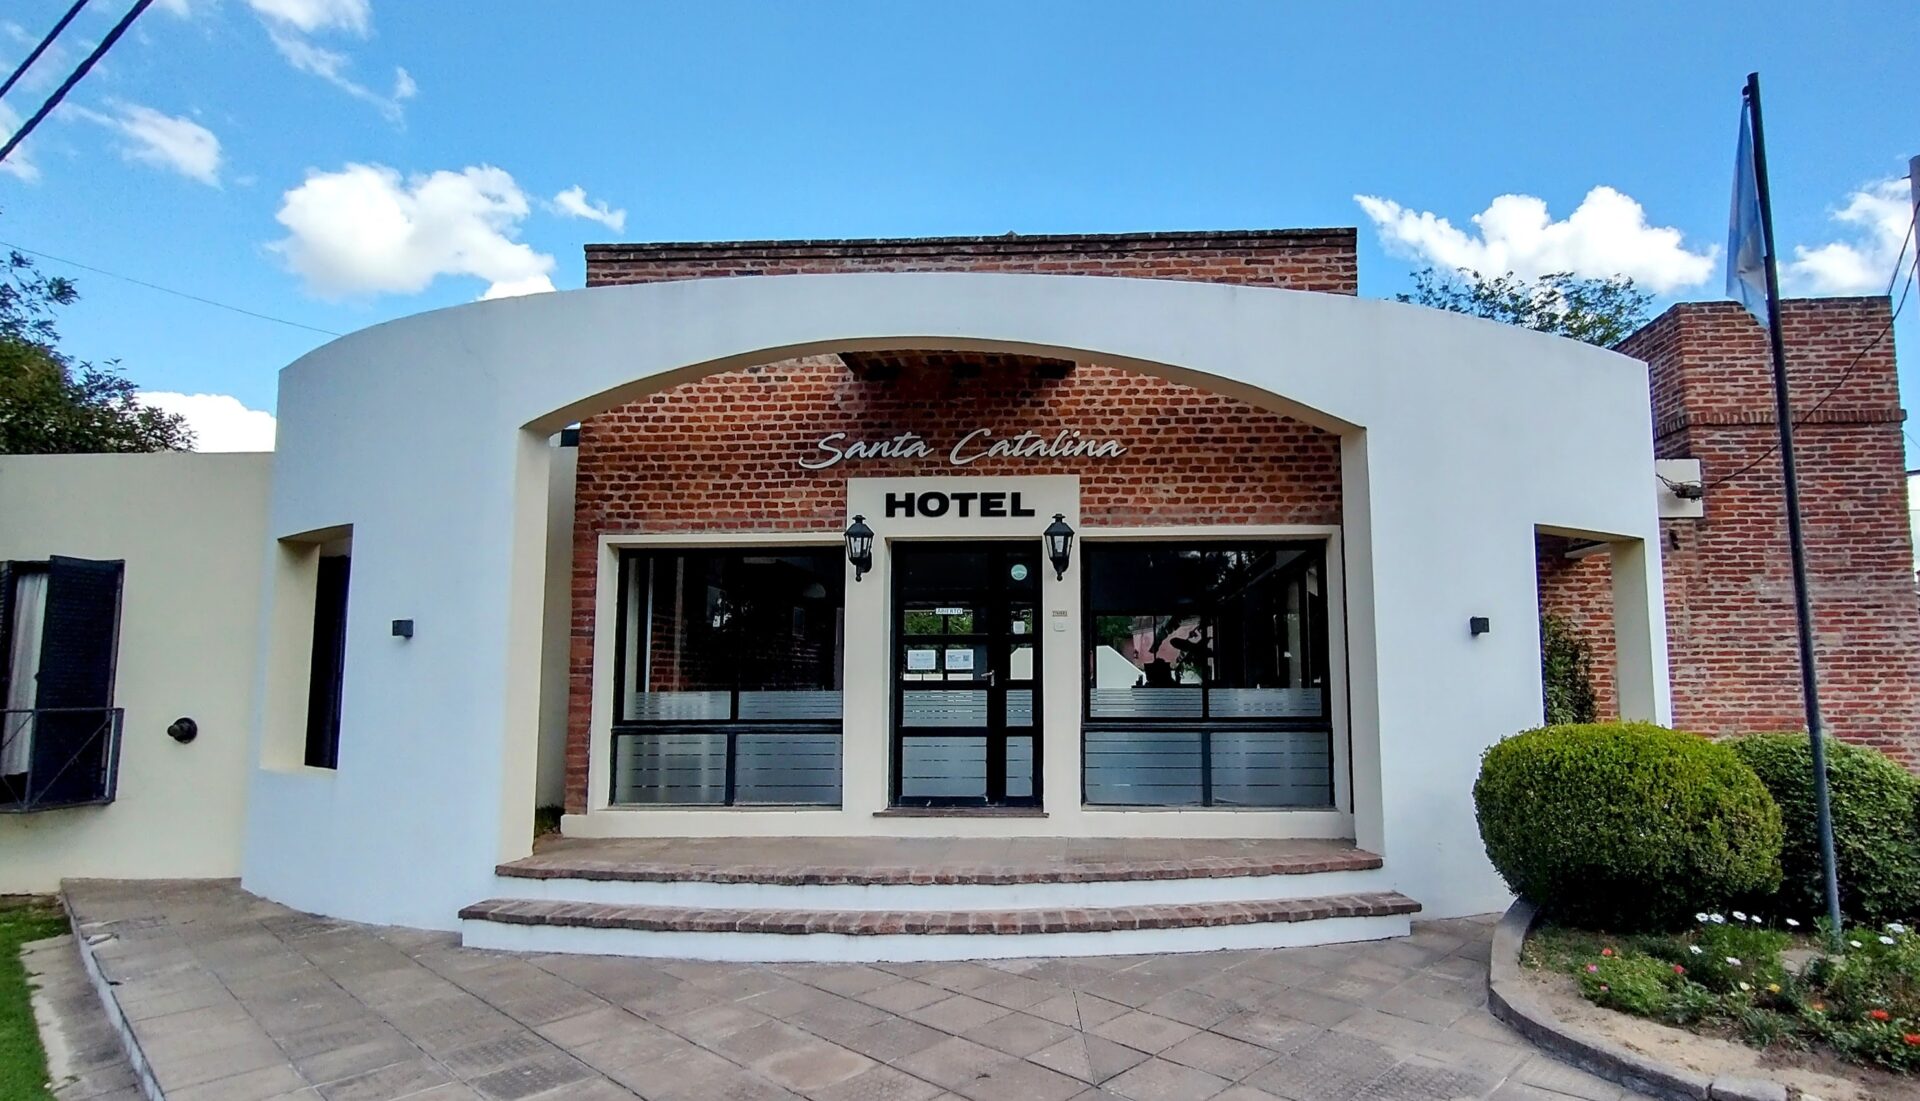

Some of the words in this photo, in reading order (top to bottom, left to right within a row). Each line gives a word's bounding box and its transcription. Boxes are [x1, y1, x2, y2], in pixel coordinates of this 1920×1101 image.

[799, 431, 934, 469] Santa
[950, 428, 1127, 465] Catalina
[885, 491, 1035, 517] HOTEL
